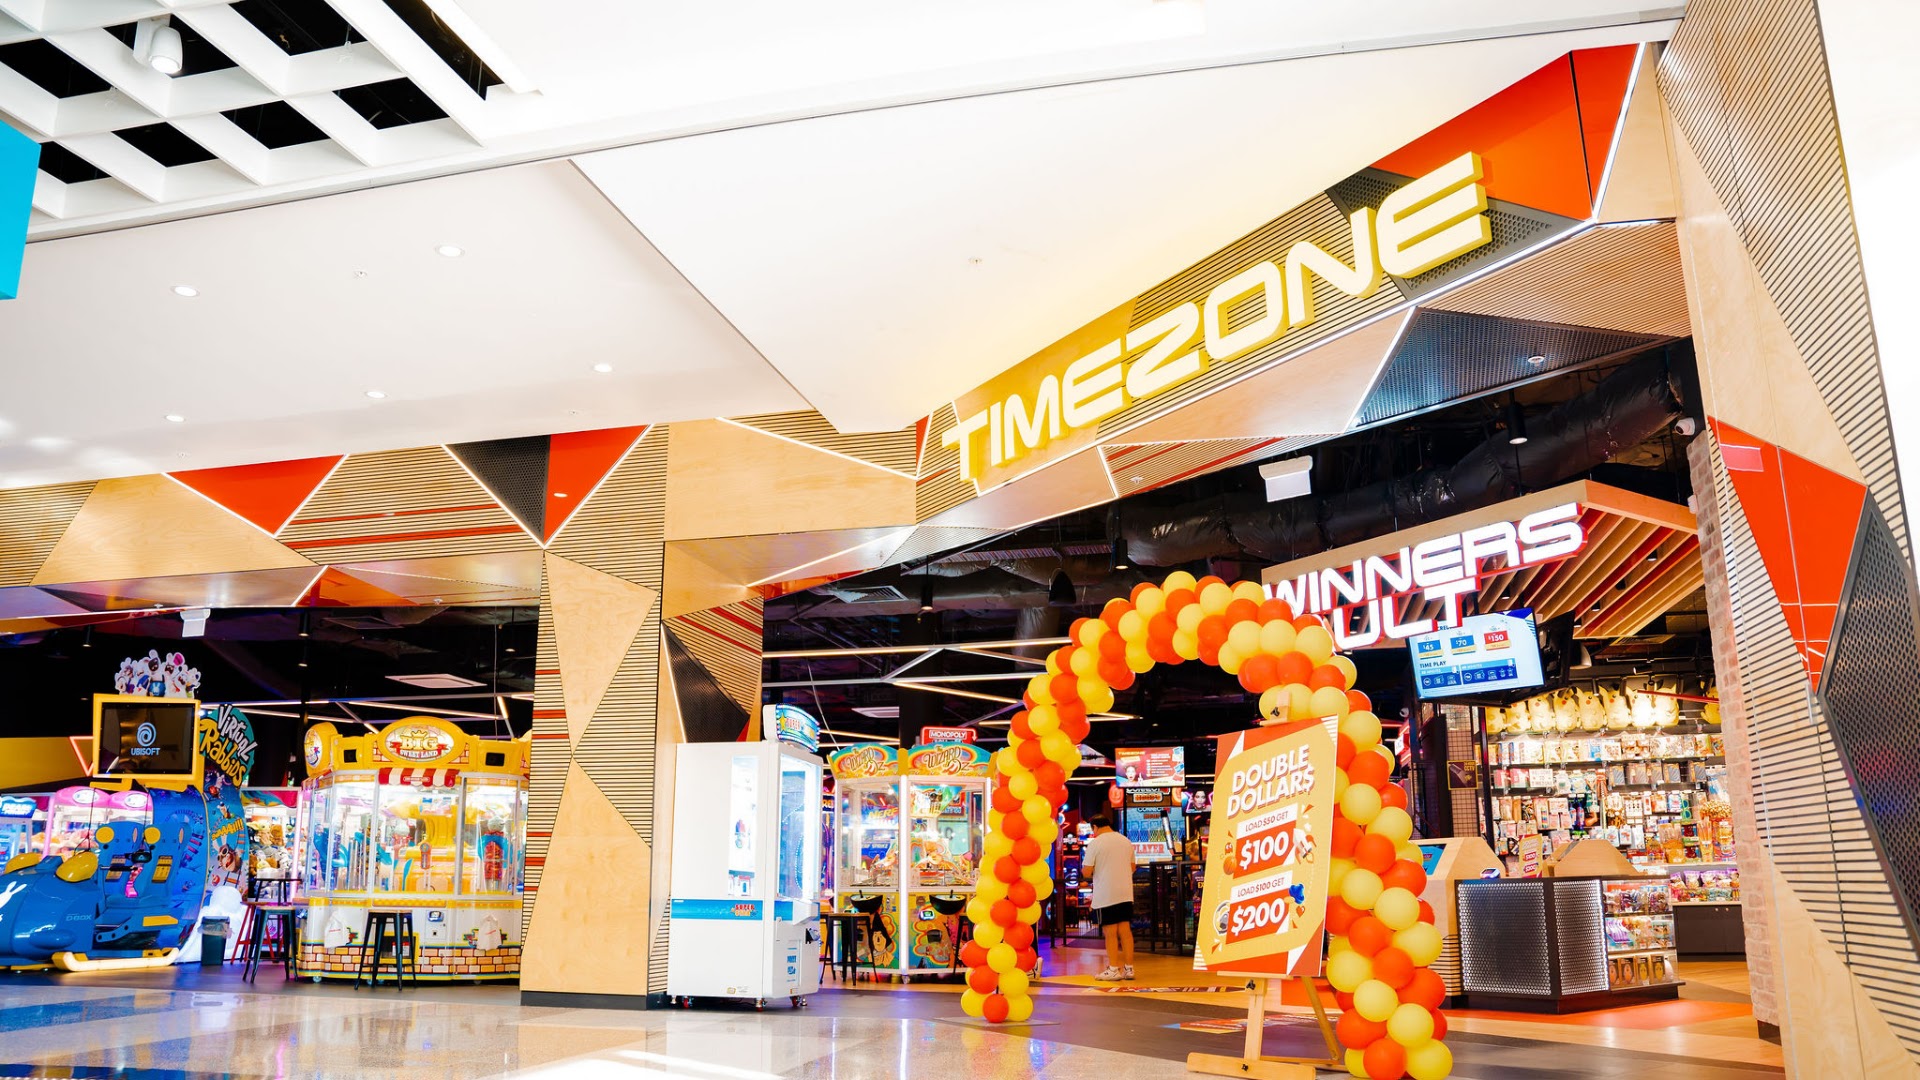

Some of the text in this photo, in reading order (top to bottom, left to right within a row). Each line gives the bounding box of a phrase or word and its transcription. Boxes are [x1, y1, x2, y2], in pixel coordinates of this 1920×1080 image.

[941, 151, 1491, 483] TIMEZONE
[1262, 502, 1587, 619] WINNERS
[1333, 578, 1481, 651] ULT
[1455, 639, 1467, 647] $70
[1488, 634, 1505, 642] $150
[130, 747, 161, 756] UBISOFT
[400, 735, 439, 751] BIG
[923, 746, 961, 769] WIZARD
[1231, 744, 1310, 795] DOUBLE
[868, 807, 898, 818] NERF
[1245, 810, 1288, 832] LOAD $50 GET
[1239, 830, 1290, 871] $100
[1237, 877, 1285, 897] LOAD $100 GET
[1231, 898, 1286, 937] $200
